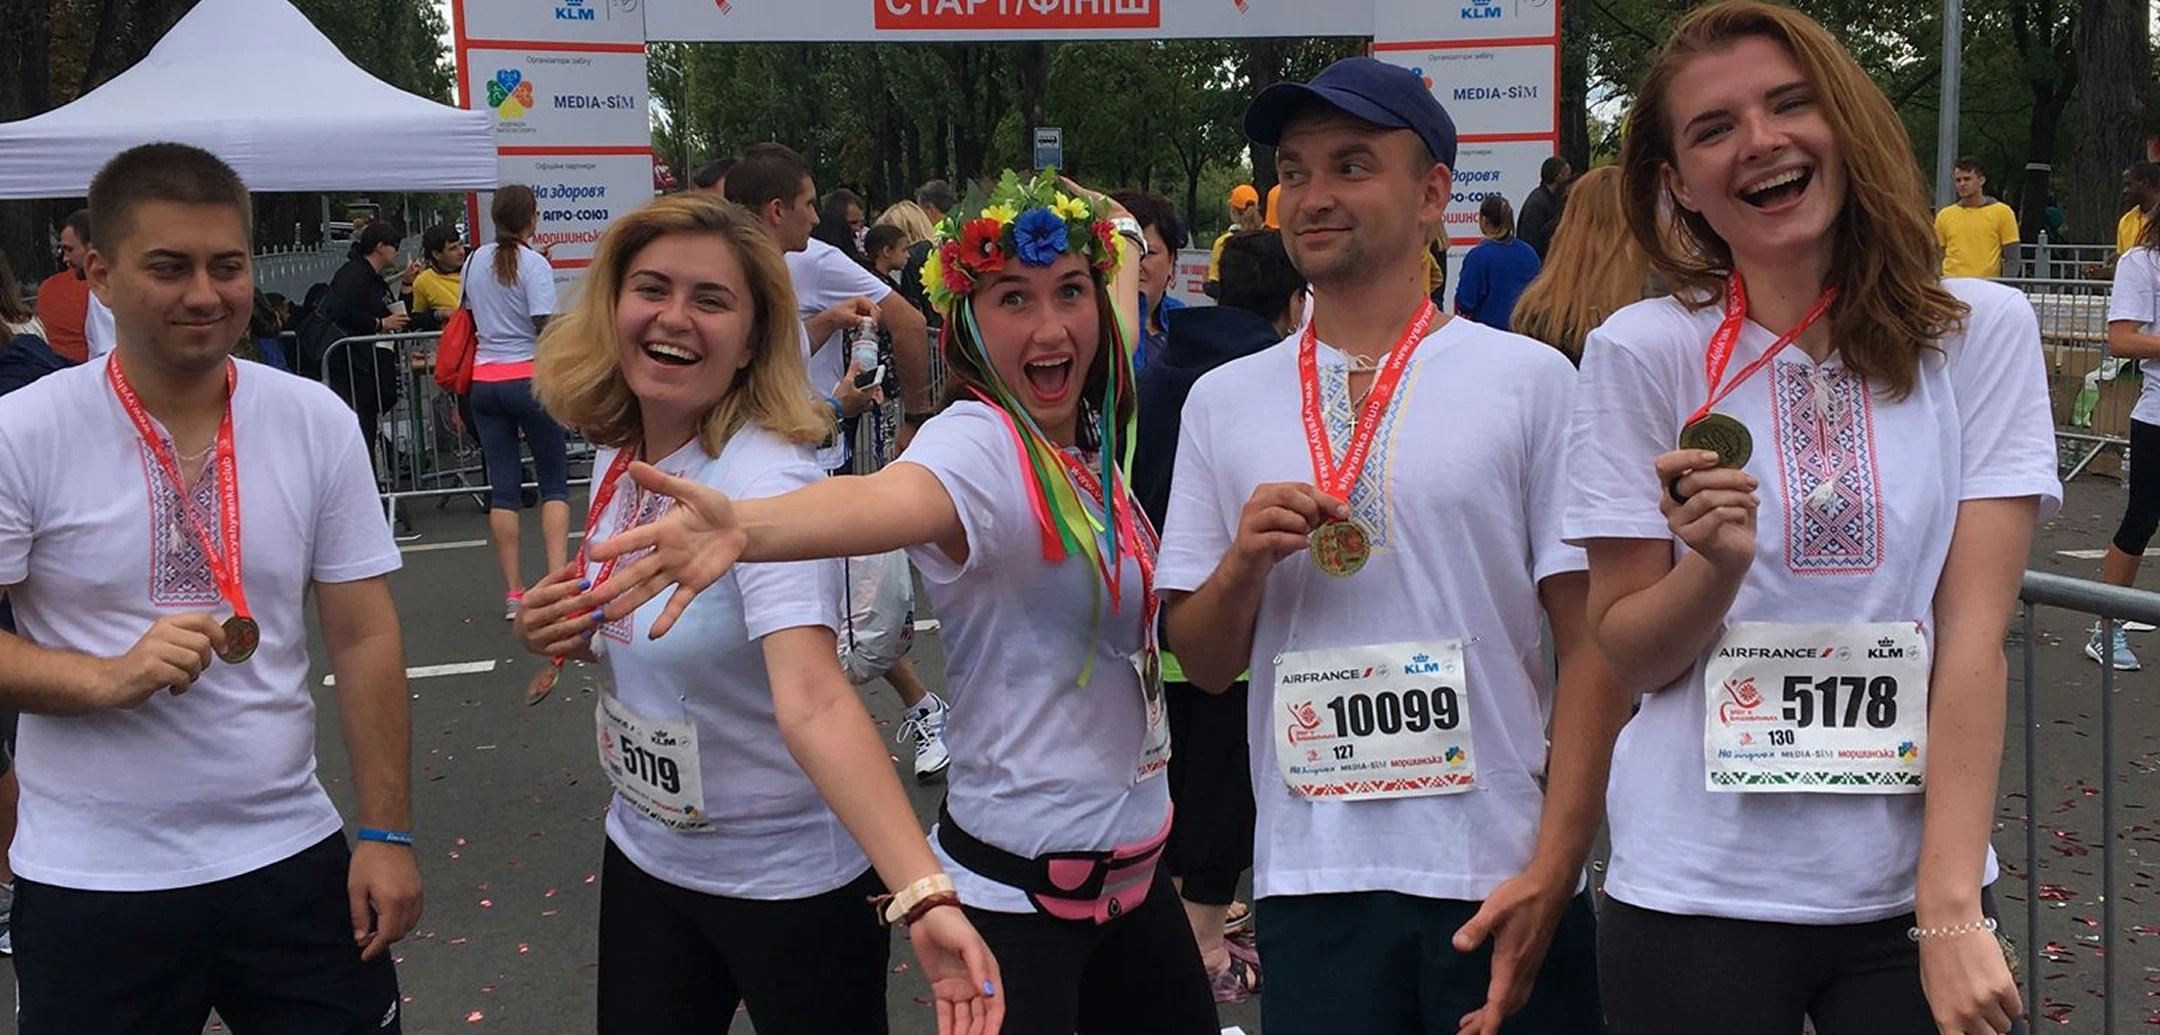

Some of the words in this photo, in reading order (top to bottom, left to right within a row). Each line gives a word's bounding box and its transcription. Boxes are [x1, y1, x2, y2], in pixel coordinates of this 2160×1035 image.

[555, 8, 595, 20] KLM
[1461, 7, 1502, 19] KLM
[223, 456, 240, 585] www.vyshyvanka.club
[1718, 647, 1817, 658] AIRFRANCE
[1868, 648, 1904, 658] KLM
[1281, 668, 1360, 685] AIRFRANCE
[1404, 663, 1439, 675] KLM
[1327, 686, 1460, 738] 10099
[1782, 676, 1898, 729] 5178
[1768, 730, 1795, 746] 130
[1333, 744, 1354, 760] 127
[620, 734, 681, 794] 5179
